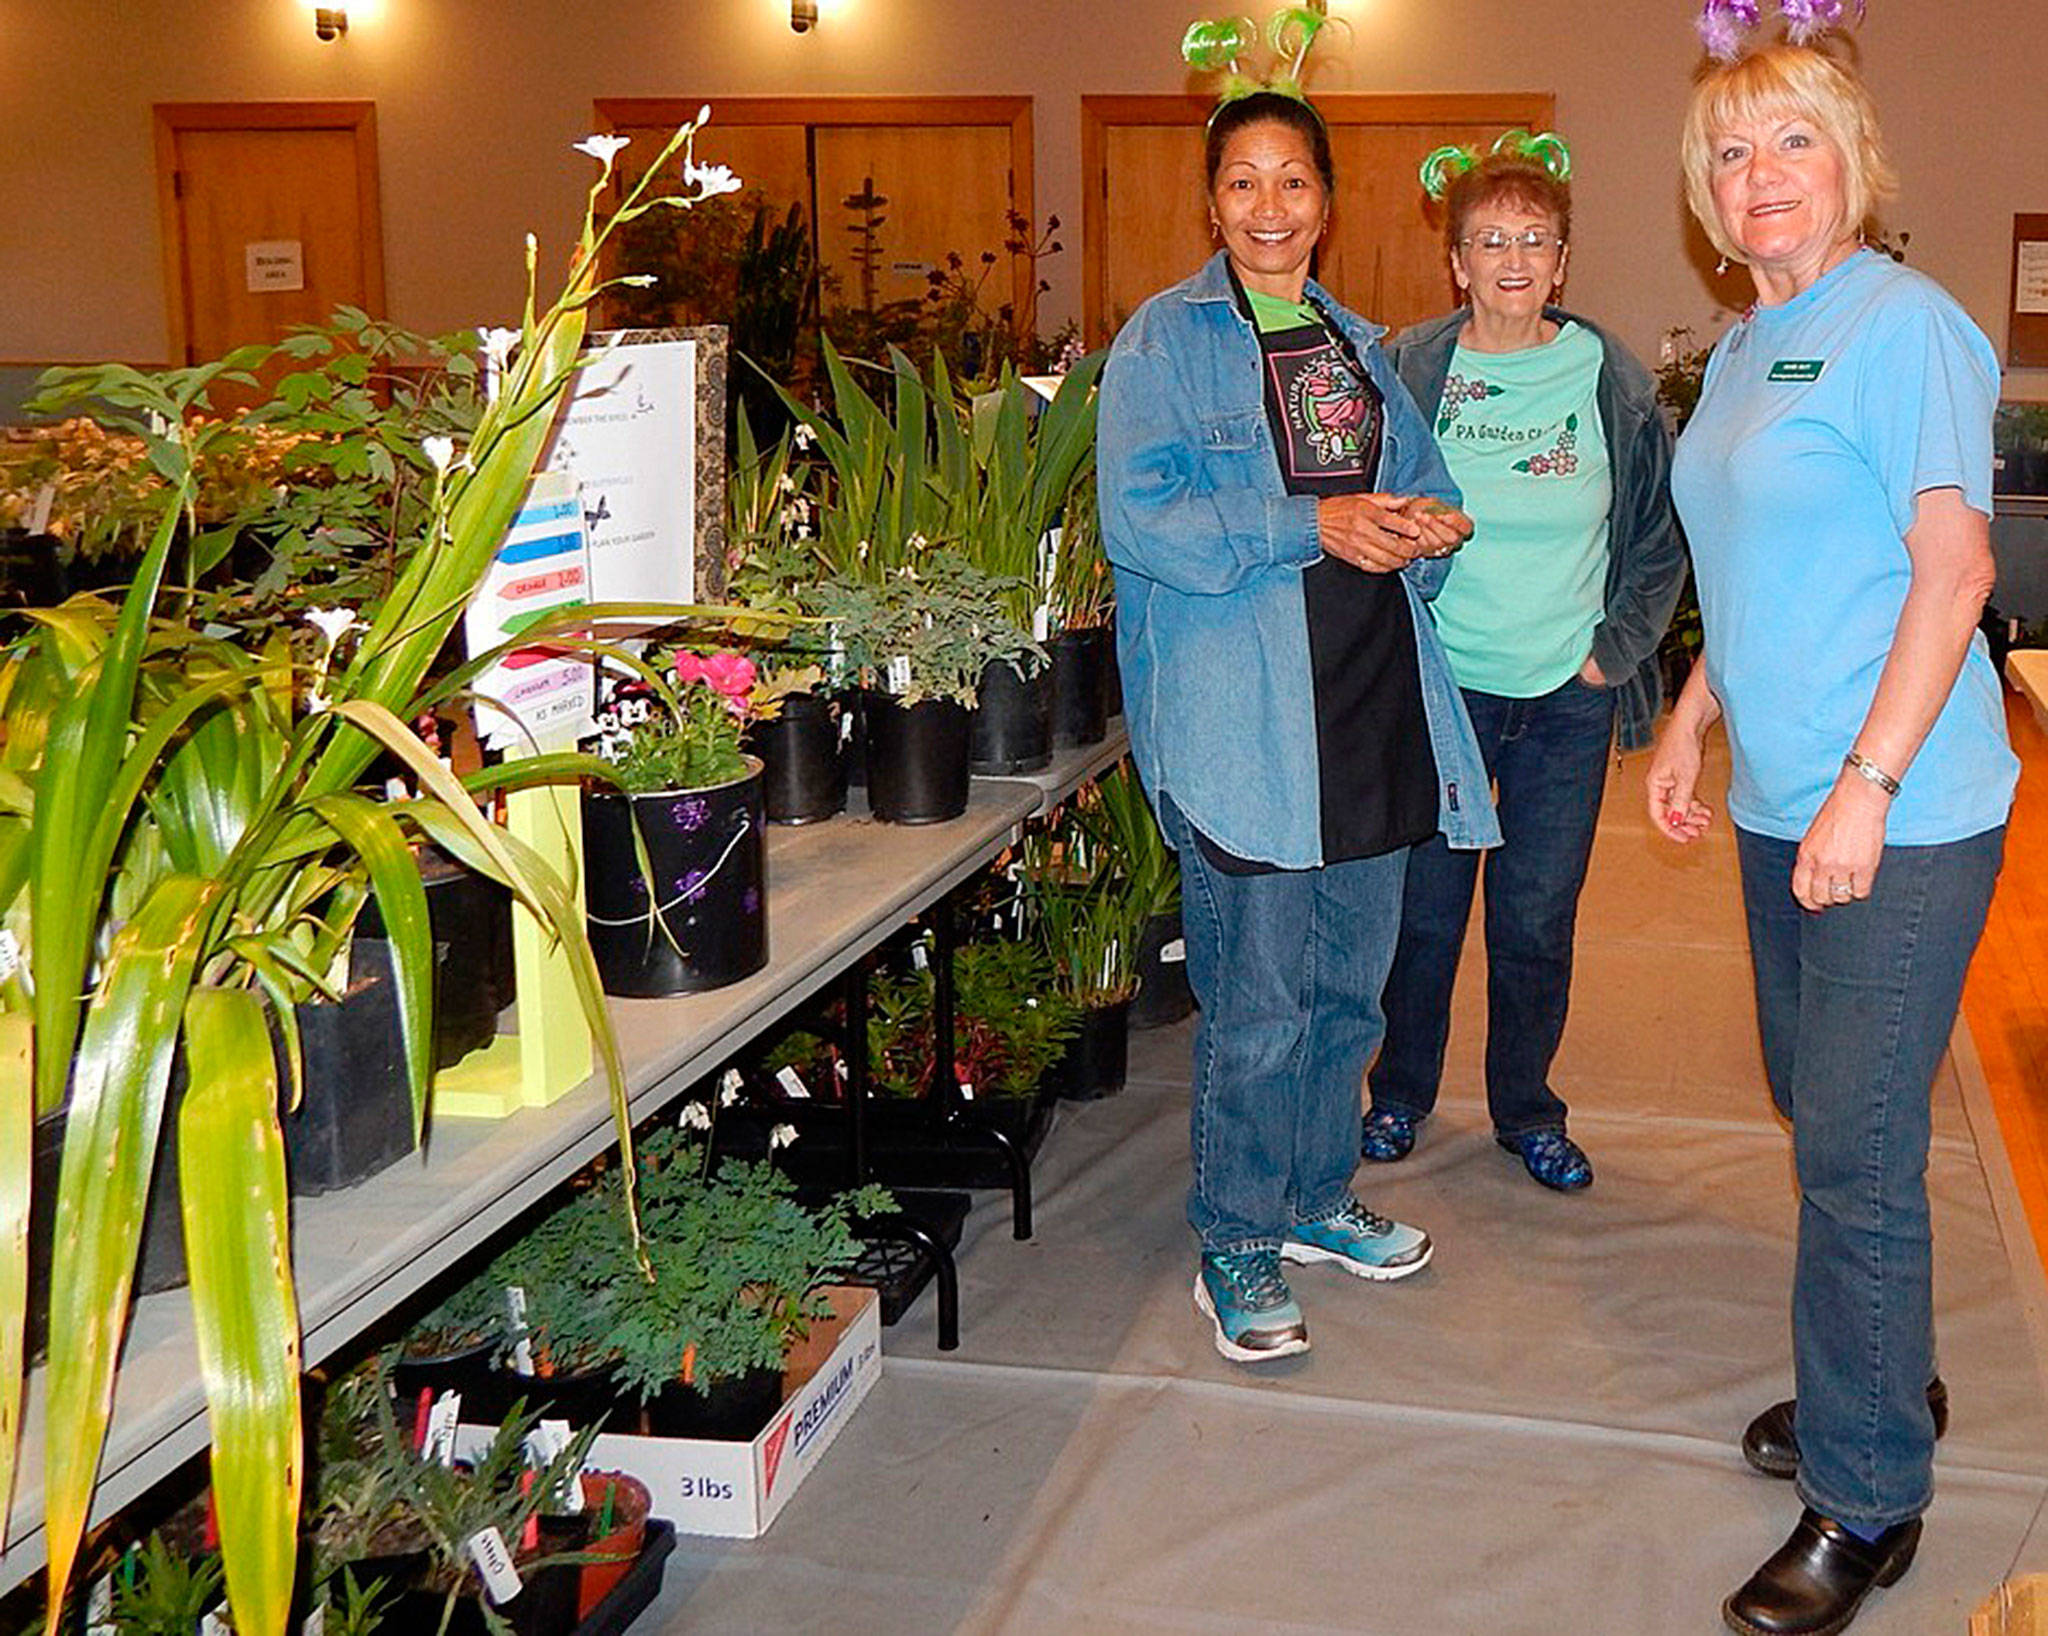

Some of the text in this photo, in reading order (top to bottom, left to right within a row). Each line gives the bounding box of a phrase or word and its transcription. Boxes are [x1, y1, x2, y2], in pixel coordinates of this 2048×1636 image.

[1291, 357, 1320, 430] NATURALLY
[1456, 424, 1476, 439] PA
[1478, 424, 1525, 441] Garden
[793, 1357, 853, 1447] PREMIUM
